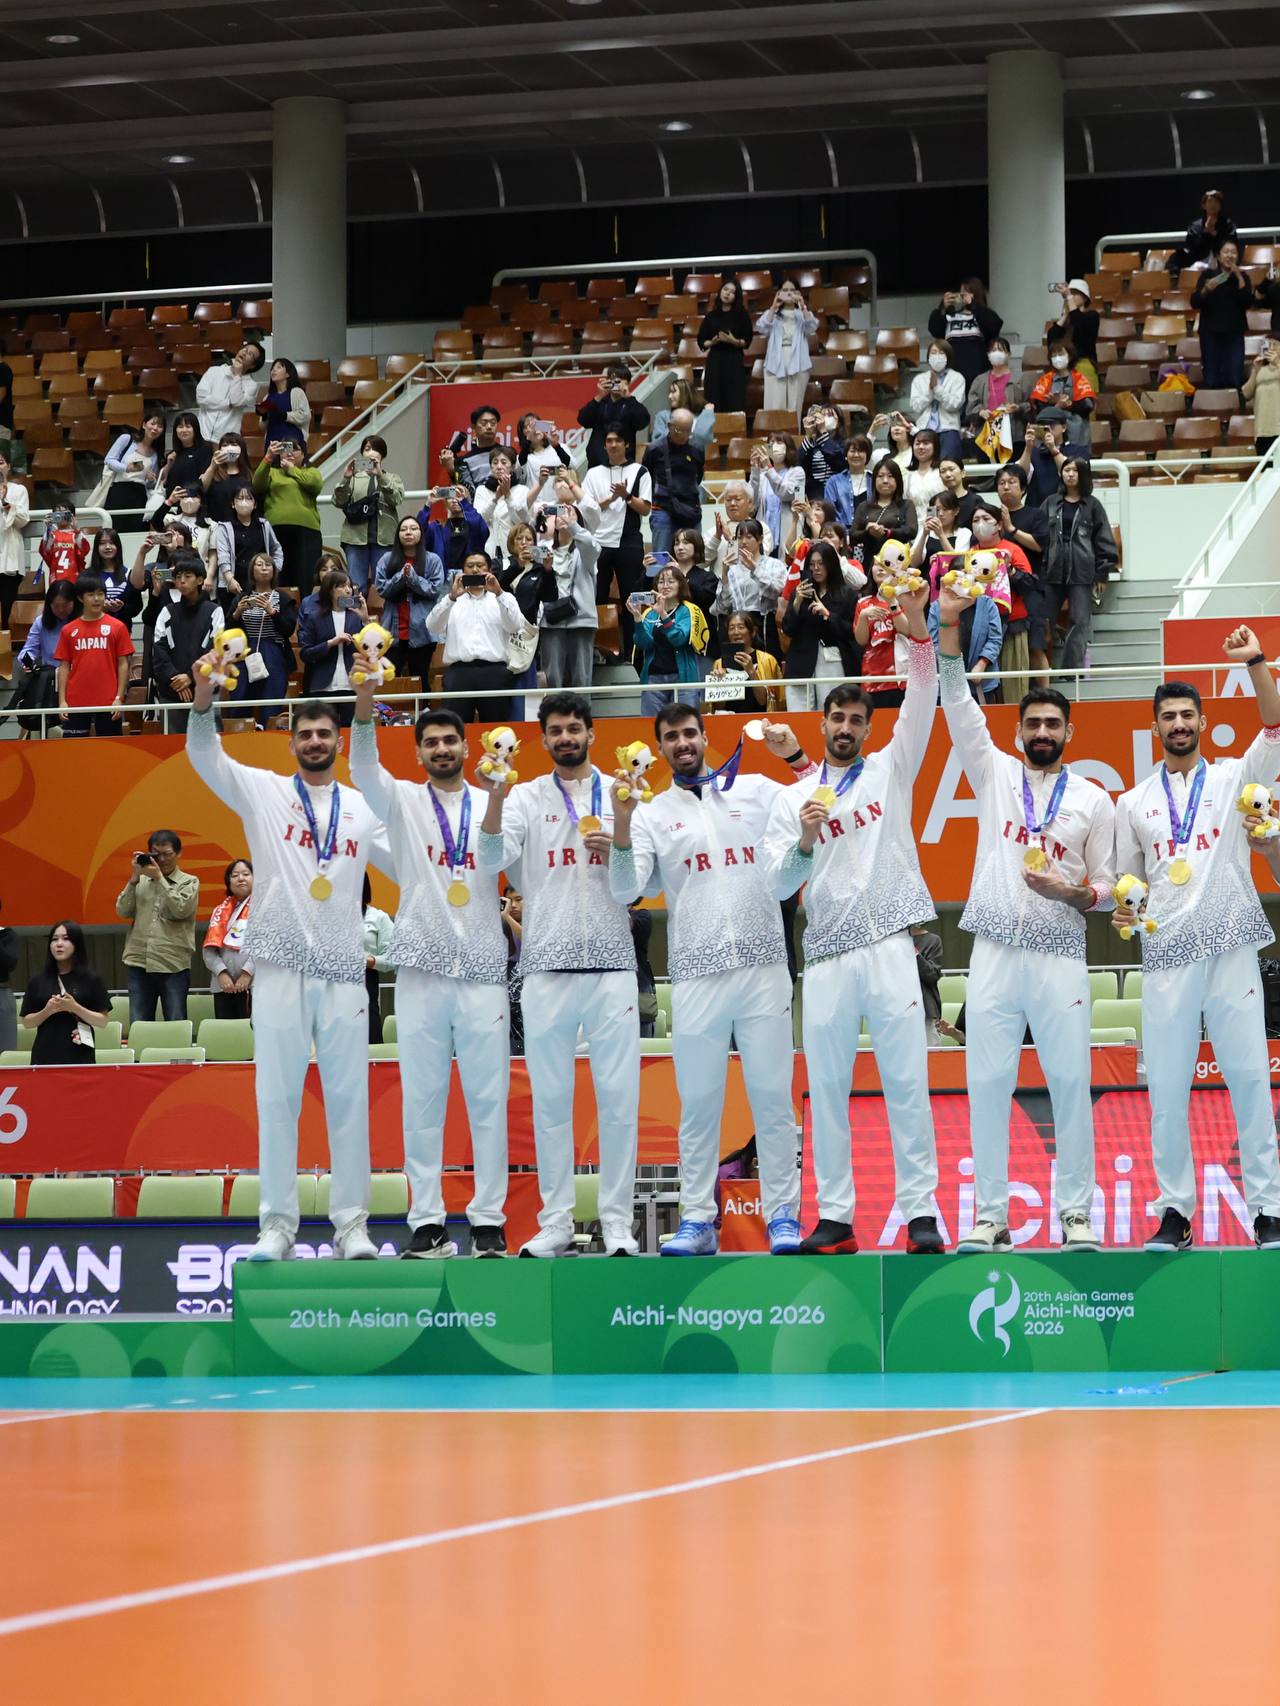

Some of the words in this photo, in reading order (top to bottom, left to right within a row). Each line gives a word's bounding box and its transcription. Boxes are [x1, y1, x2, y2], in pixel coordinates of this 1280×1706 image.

[75, 636, 108, 651] JAPAN
[817, 801, 883, 845] IRAN
[1145, 808, 1162, 820] I.R.
[669, 822, 686, 833] I.R.
[547, 848, 603, 869] IRA
[684, 846, 756, 876] IRAN
[1023, 1291, 1052, 1302] 20th
[1055, 1290, 1088, 1302] Asian
[1091, 1291, 1134, 1302] Games
[289, 1309, 341, 1329] 20th
[348, 1308, 409, 1328] Asian
[416, 1309, 497, 1329] Games
[611, 1305, 764, 1331] Aichi-Nagoya
[769, 1305, 826, 1325] 2026
[1024, 1303, 1135, 1322] Aichi-Nagoya
[1024, 1321, 1065, 1335] 2026
